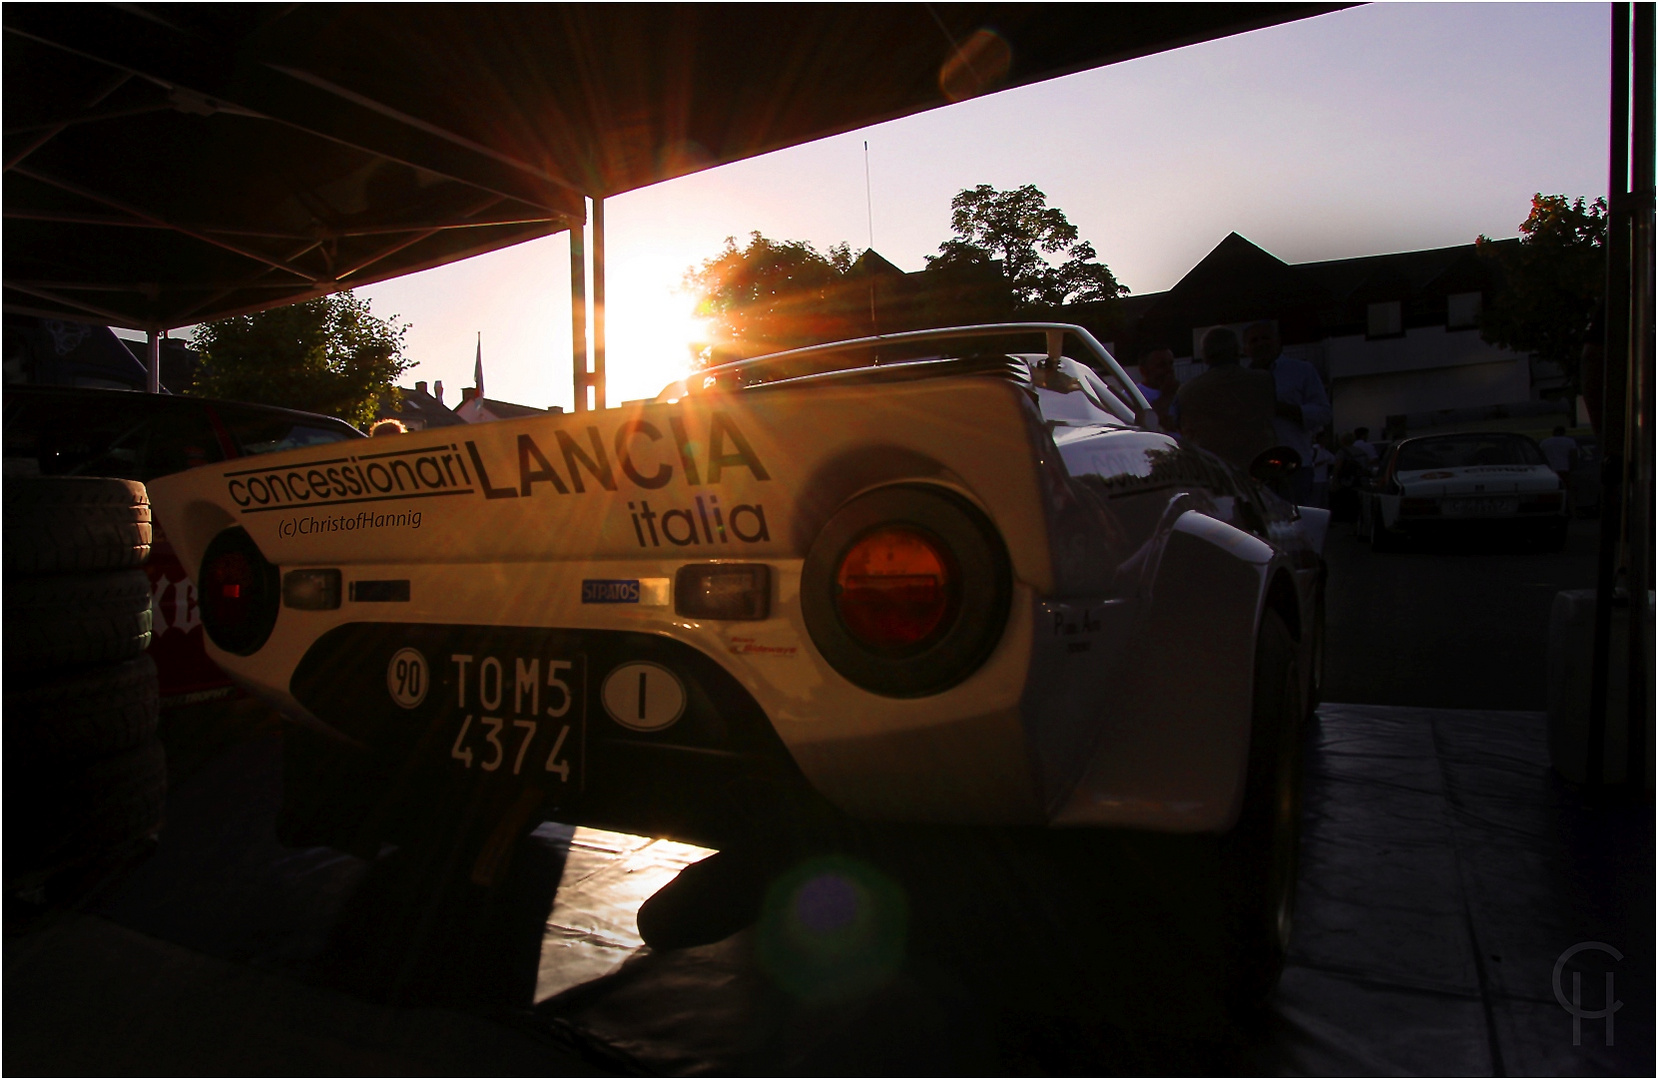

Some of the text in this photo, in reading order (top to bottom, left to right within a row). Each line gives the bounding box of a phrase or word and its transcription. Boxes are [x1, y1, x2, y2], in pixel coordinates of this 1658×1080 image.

[228, 411, 771, 507] concessionari LANCIA
[629, 496, 771, 548] italia
[584, 583, 639, 601] STRATOS
[396, 660, 420, 697] 90
[451, 716, 570, 783] 4374
